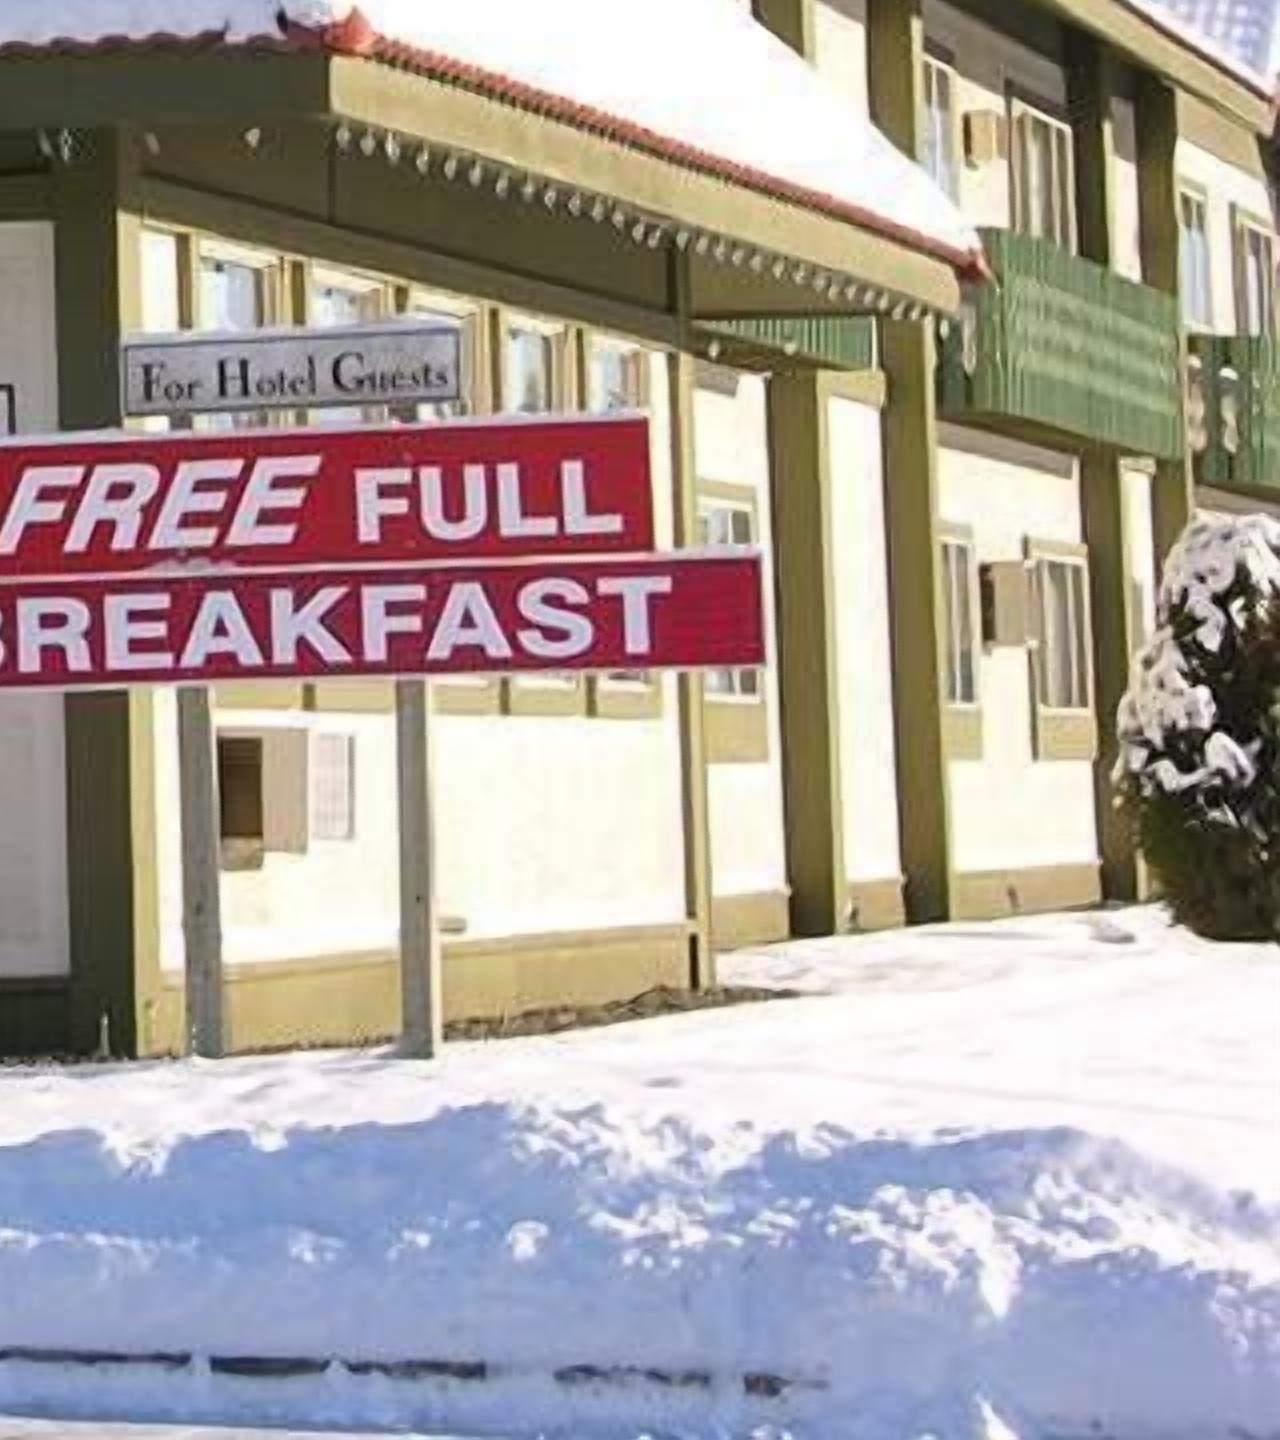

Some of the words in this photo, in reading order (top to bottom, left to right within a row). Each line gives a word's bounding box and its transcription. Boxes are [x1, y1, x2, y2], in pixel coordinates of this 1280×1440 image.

[139, 361, 202, 402] For
[216, 355, 317, 397] Hotel
[332, 351, 449, 393] Guests
[353, 459, 625, 543] FULL
